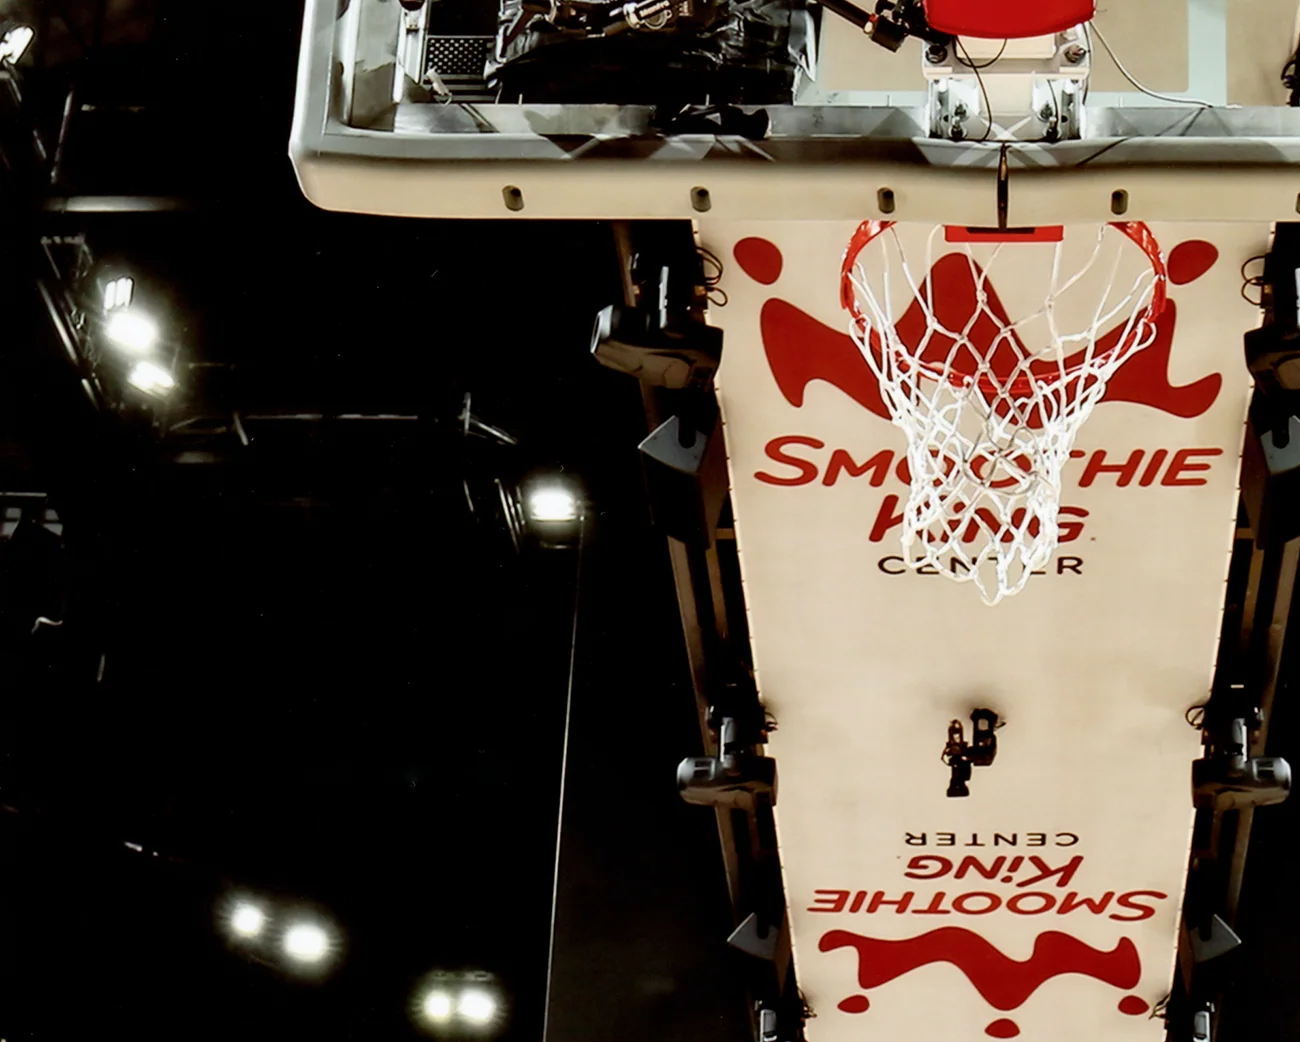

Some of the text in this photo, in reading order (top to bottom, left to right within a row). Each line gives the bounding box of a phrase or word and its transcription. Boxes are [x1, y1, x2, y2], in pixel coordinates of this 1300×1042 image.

[878, 556, 1084, 575] CENR
[905, 832, 1079, 847] CENTER
[806, 889, 1168, 921] SMOOTHIE
